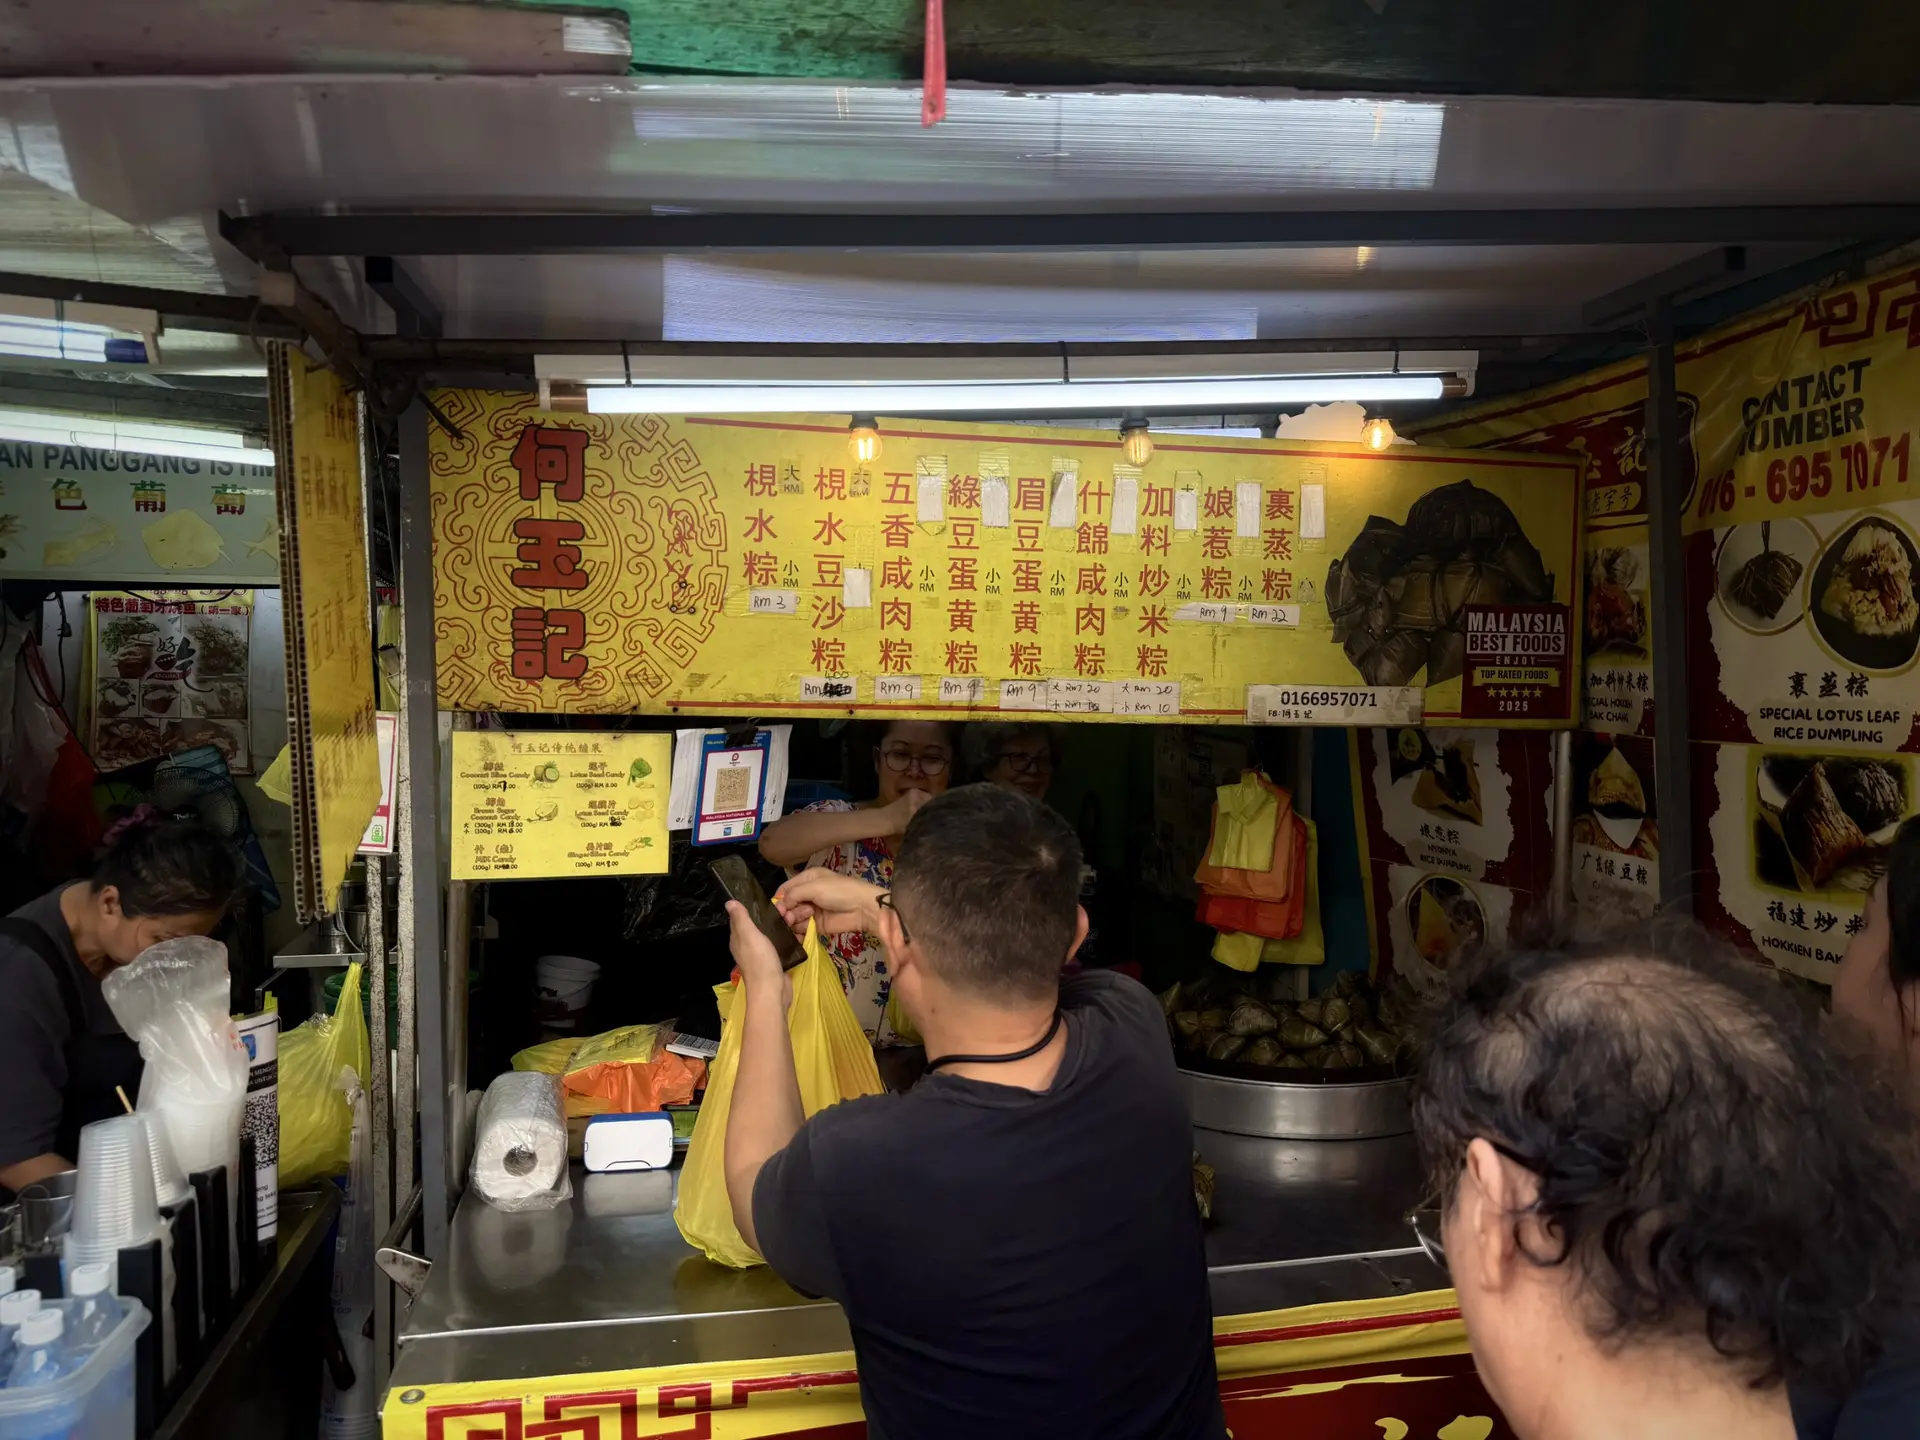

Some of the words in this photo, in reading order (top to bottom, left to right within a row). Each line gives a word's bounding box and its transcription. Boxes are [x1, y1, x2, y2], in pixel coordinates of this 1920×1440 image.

[44, 446, 200, 475] PANGGANG
[783, 464, 800, 481] 大
[1767, 451, 1832, 504] 695
[783, 484, 800, 493] RM
[1200, 486, 1233, 599] 娘惹粽
[510, 424, 589, 679] 何玉記
[782, 560, 800, 576] 小
[879, 471, 914, 673] 五香咸肉粽
[920, 565, 935, 581] 小
[986, 568, 1000, 583] 小
[782, 578, 799, 587] RM
[1050, 570, 1065, 585] 小
[1114, 572, 1129, 587] 小
[1136, 482, 1173, 678] 加料炒米粽
[1177, 573, 1191, 589] 小
[1239, 575, 1253, 591] 小
[920, 583, 934, 592] RM
[986, 585, 1000, 594] RM
[1050, 587, 1065, 596] RM
[1114, 589, 1128, 598] RM
[1177, 591, 1191, 600] RM
[1238, 592, 1252, 601] RM
[1468, 612, 1564, 633] MALAYSIA
[1469, 634, 1508, 651] BEST
[1512, 635, 1562, 652] FOODS
[1496, 656, 1536, 665] ENJOY
[1481, 669, 1496, 679] TOP
[1498, 670, 1522, 679] RATED
[1524, 670, 1549, 679] FOODS
[1281, 691, 1378, 707] 0166957071
[1499, 701, 1529, 711] 2025
[1158, 703, 1170, 713] 10
[1760, 708, 1812, 721] SPECIAL
[1817, 709, 1863, 722] LOTUS
[1867, 710, 1900, 723] LEAF
[1774, 727, 1804, 739] RICE
[1808, 728, 1883, 743] DUMPLING
[605, 771, 625, 779] Candy
[610, 809, 629, 817] Candy
[492, 855, 516, 863] Candy
[608, 850, 630, 858] Candy
[1420, 855, 1436, 865] RICE
[1762, 936, 1812, 958] HOKKIEN
